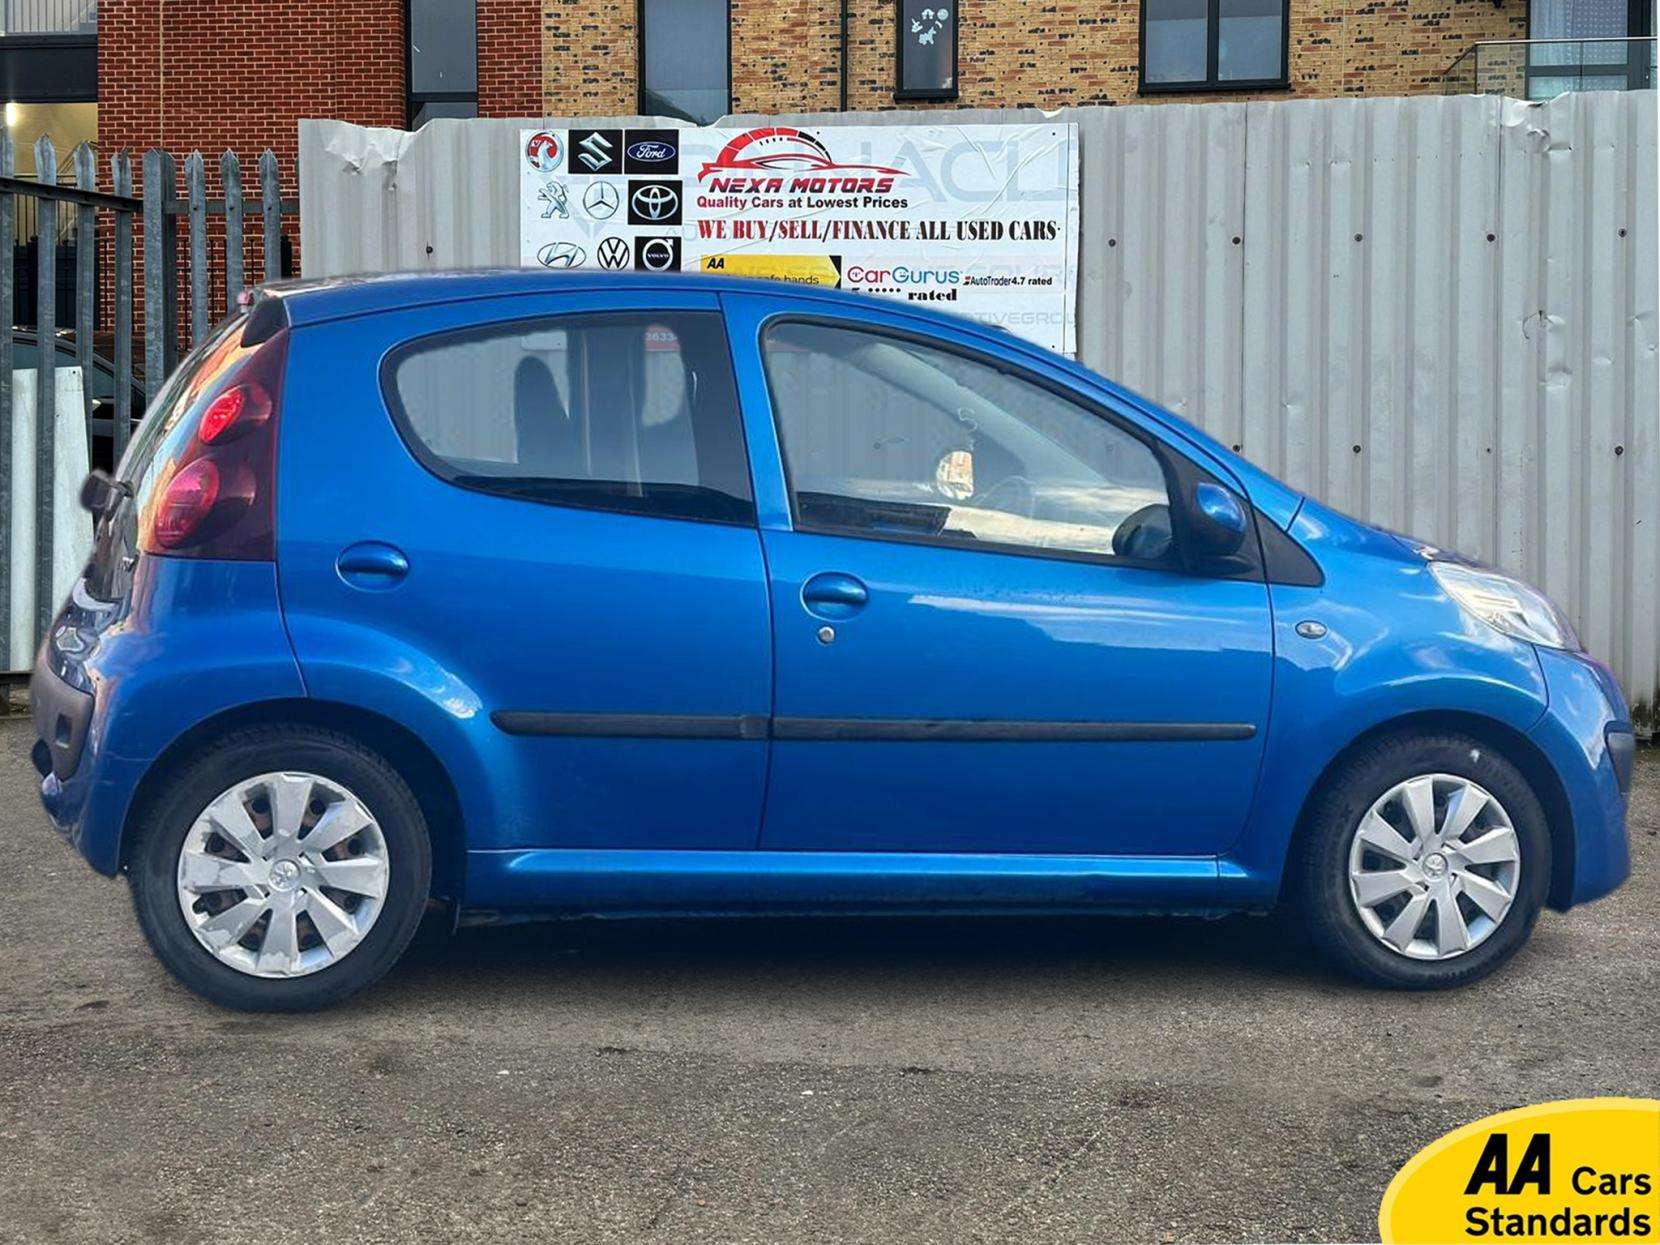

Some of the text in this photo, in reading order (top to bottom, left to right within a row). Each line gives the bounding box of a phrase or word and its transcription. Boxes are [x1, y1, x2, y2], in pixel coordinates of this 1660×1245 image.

[636, 144, 666, 158] Ford
[709, 178, 894, 193] NEXA MOTORS
[697, 196, 908, 210] Quality Cars at Lowest Prices
[697, 220, 726, 239] WE
[916, 220, 950, 240] ALL
[956, 220, 1004, 240] USED
[1009, 220, 1057, 240] CARS
[707, 258, 724, 269] AA
[1028, 277, 1053, 286] rated
[908, 288, 957, 301] rated
